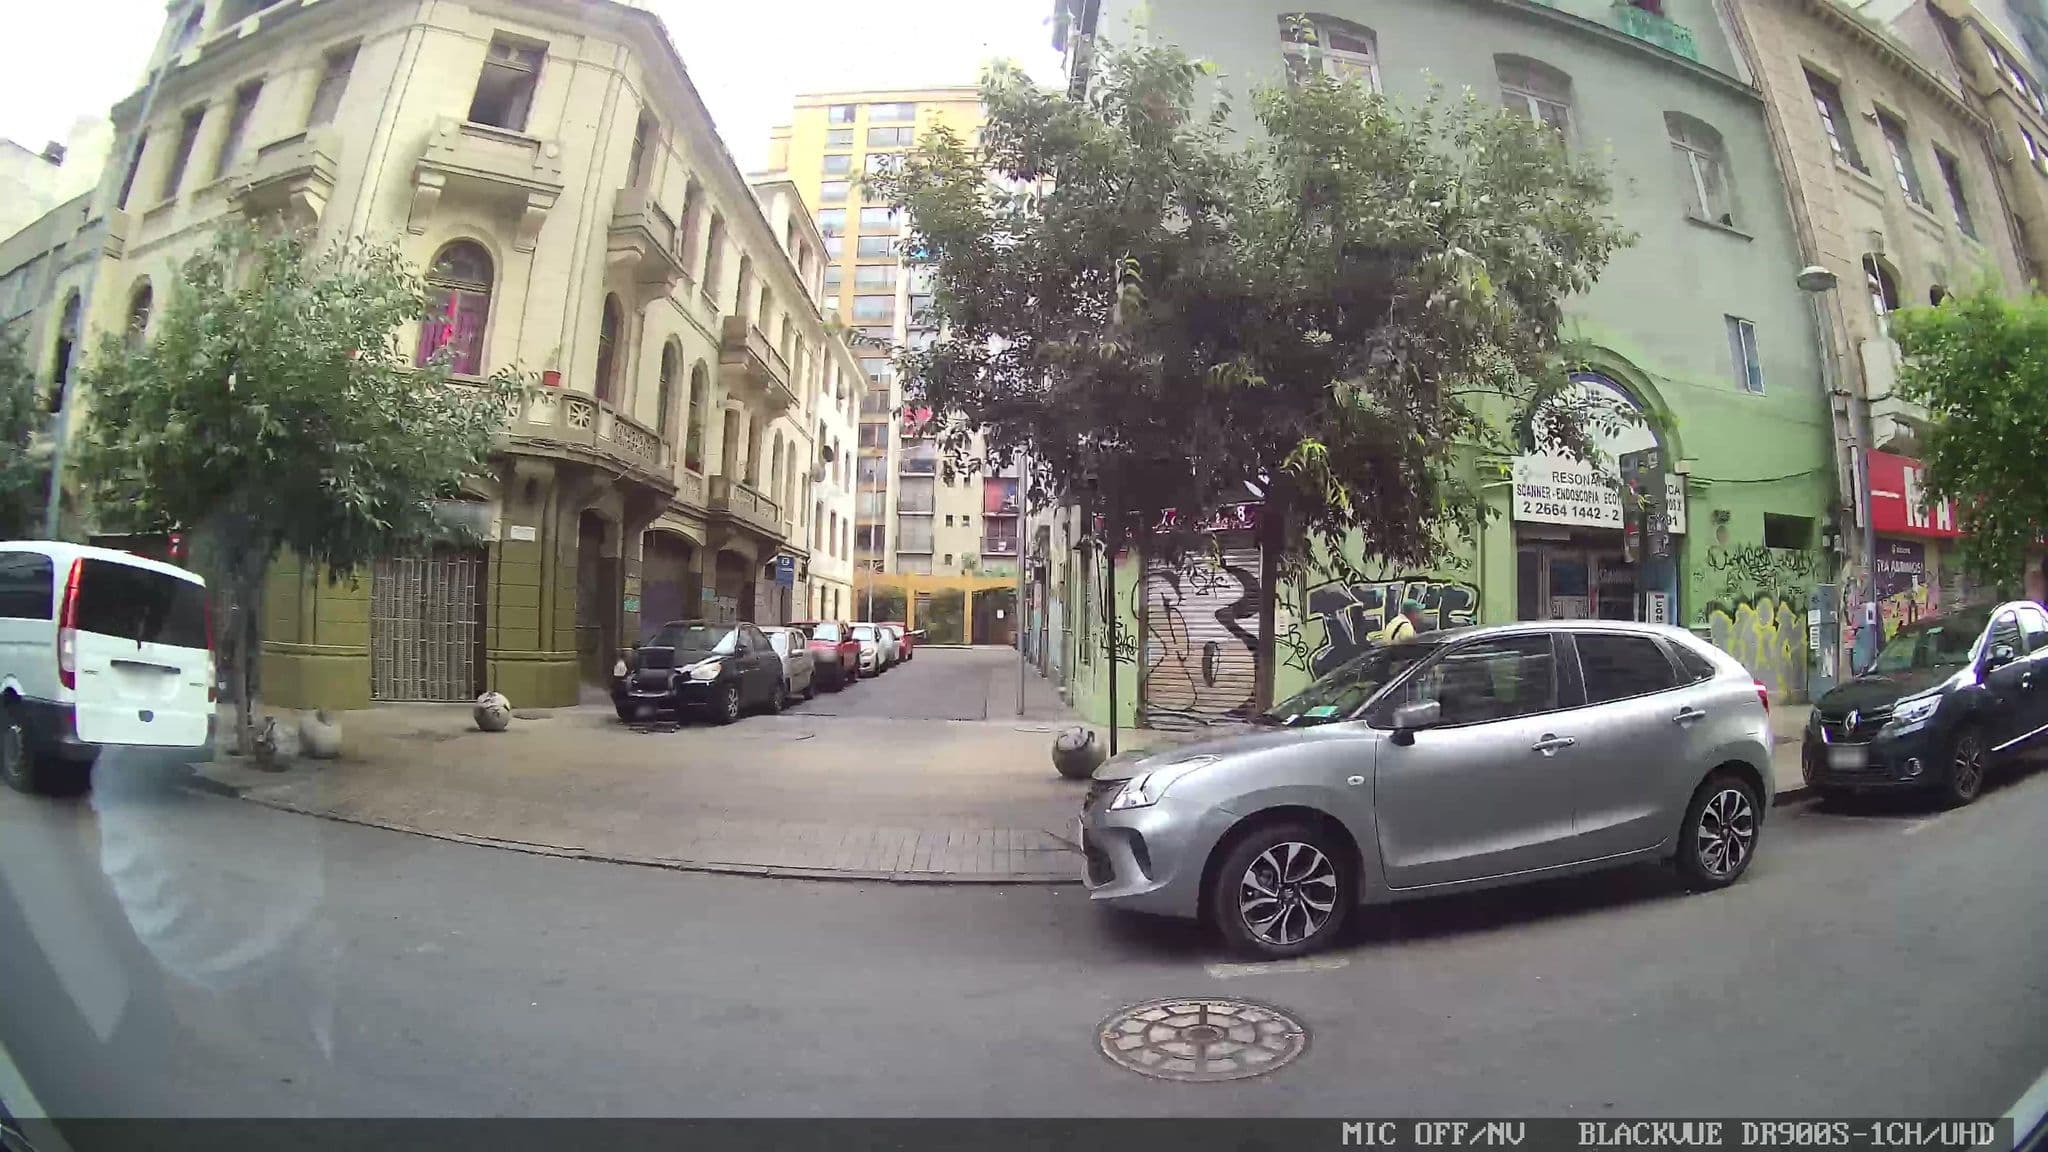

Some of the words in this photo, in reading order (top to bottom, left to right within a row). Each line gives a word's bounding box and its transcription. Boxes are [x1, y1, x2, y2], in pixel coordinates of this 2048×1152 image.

[1516, 483, 1551, 500] SCANNER
[1556, 487, 1600, 504] ENDOSCOPIA
[1523, 501, 1532, 514] 2
[1535, 502, 1568, 517] 2664
[1572, 506, 1601, 520] 1442
